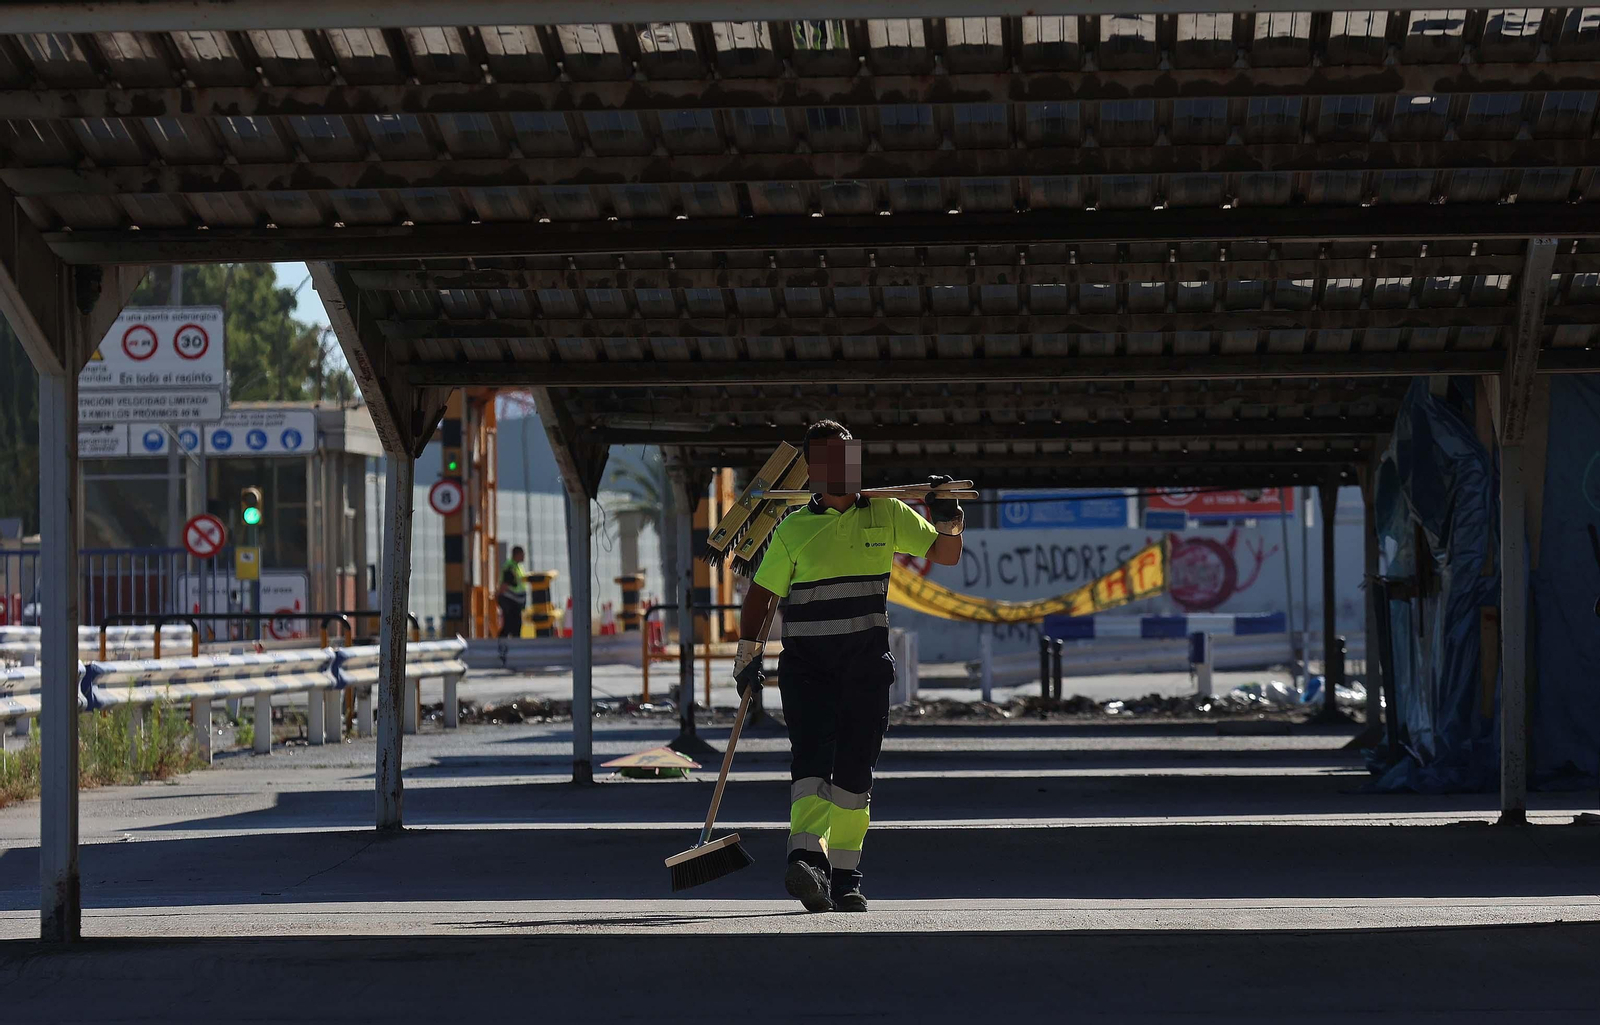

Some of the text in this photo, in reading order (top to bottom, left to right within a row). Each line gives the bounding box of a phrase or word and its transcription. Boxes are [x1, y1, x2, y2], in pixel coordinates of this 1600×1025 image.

[180, 335, 203, 348] 30
[119, 371, 213, 384] En todo el recinto
[79, 395, 208, 407] ENCIÓN! VELOCIDAD LIMITADA
[133, 407, 178, 418] PRÓXIMOS
